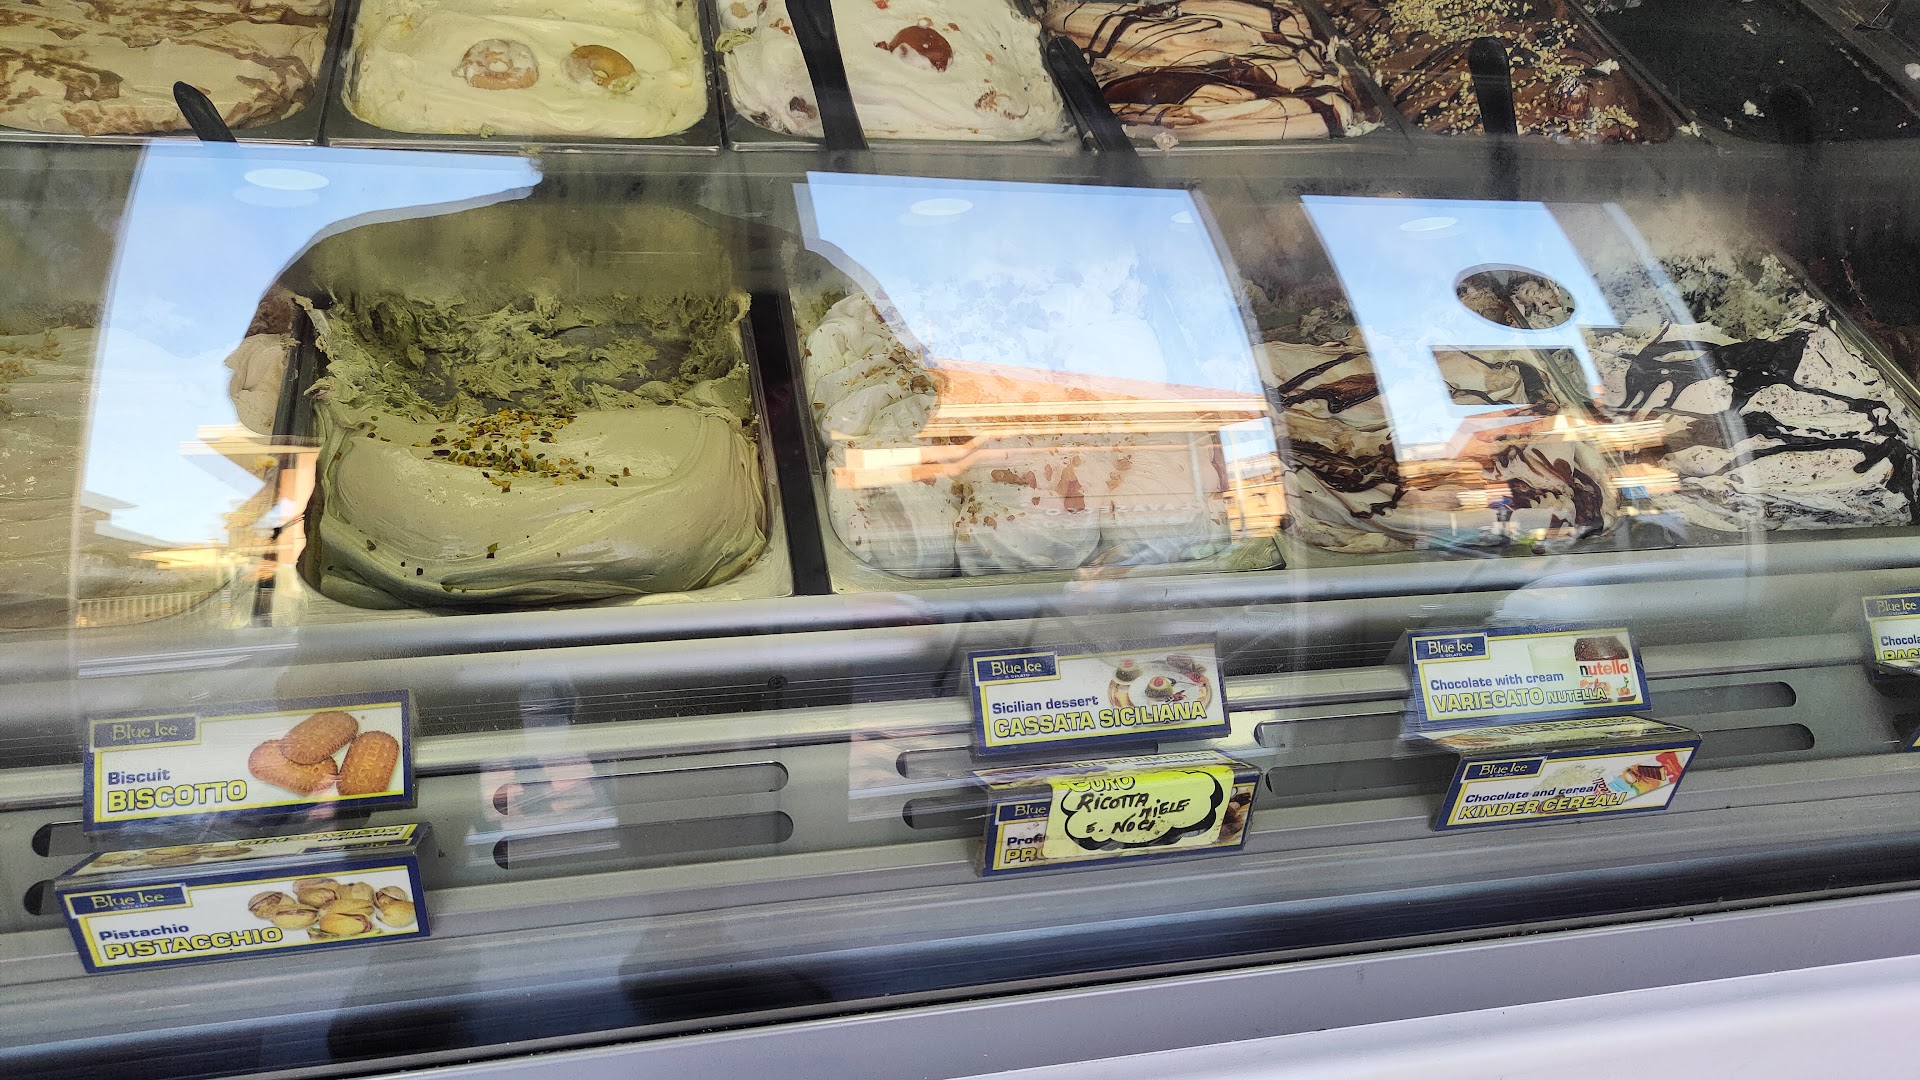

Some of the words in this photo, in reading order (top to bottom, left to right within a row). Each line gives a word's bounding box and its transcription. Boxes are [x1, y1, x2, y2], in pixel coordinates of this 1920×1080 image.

[1876, 600, 1901, 612] Blue
[1901, 598, 1917, 610] Ice
[1427, 641, 1455, 655] Blue
[1456, 639, 1473, 652] Ice
[990, 660, 1021, 676] Blue
[1023, 659, 1042, 672] Ice
[1579, 659, 1630, 676] nutella
[1430, 677, 1492, 691] Chocolate
[1495, 674, 1523, 686] with
[1525, 672, 1564, 684] cream
[992, 700, 1042, 715] Sicilian
[1045, 695, 1099, 710] dessert
[1432, 686, 1544, 713] VARIEGATO
[1546, 687, 1608, 704] NUTELLA
[993, 710, 1096, 738] CASSATA
[1099, 701, 1207, 728] SICILIANA
[111, 724, 151, 741] Blue
[154, 721, 179, 737] Ice
[108, 768, 171, 785] Biscuit
[1478, 764, 1508, 776] Blue
[1508, 762, 1528, 773] Ice
[107, 779, 248, 813] BISCOTTO
[1465, 791, 1529, 803] Chocolate
[1531, 787, 1556, 798] and
[1558, 783, 1598, 795] cereal
[1014, 804, 1047, 817] Blue
[1458, 800, 1539, 820] KINDER
[1542, 792, 1627, 813] CEREALI
[90, 895, 137, 909] Blue
[139, 891, 166, 904] Ice
[99, 924, 190, 941] Pistachio
[103, 927, 284, 960] PISTACCHIO
